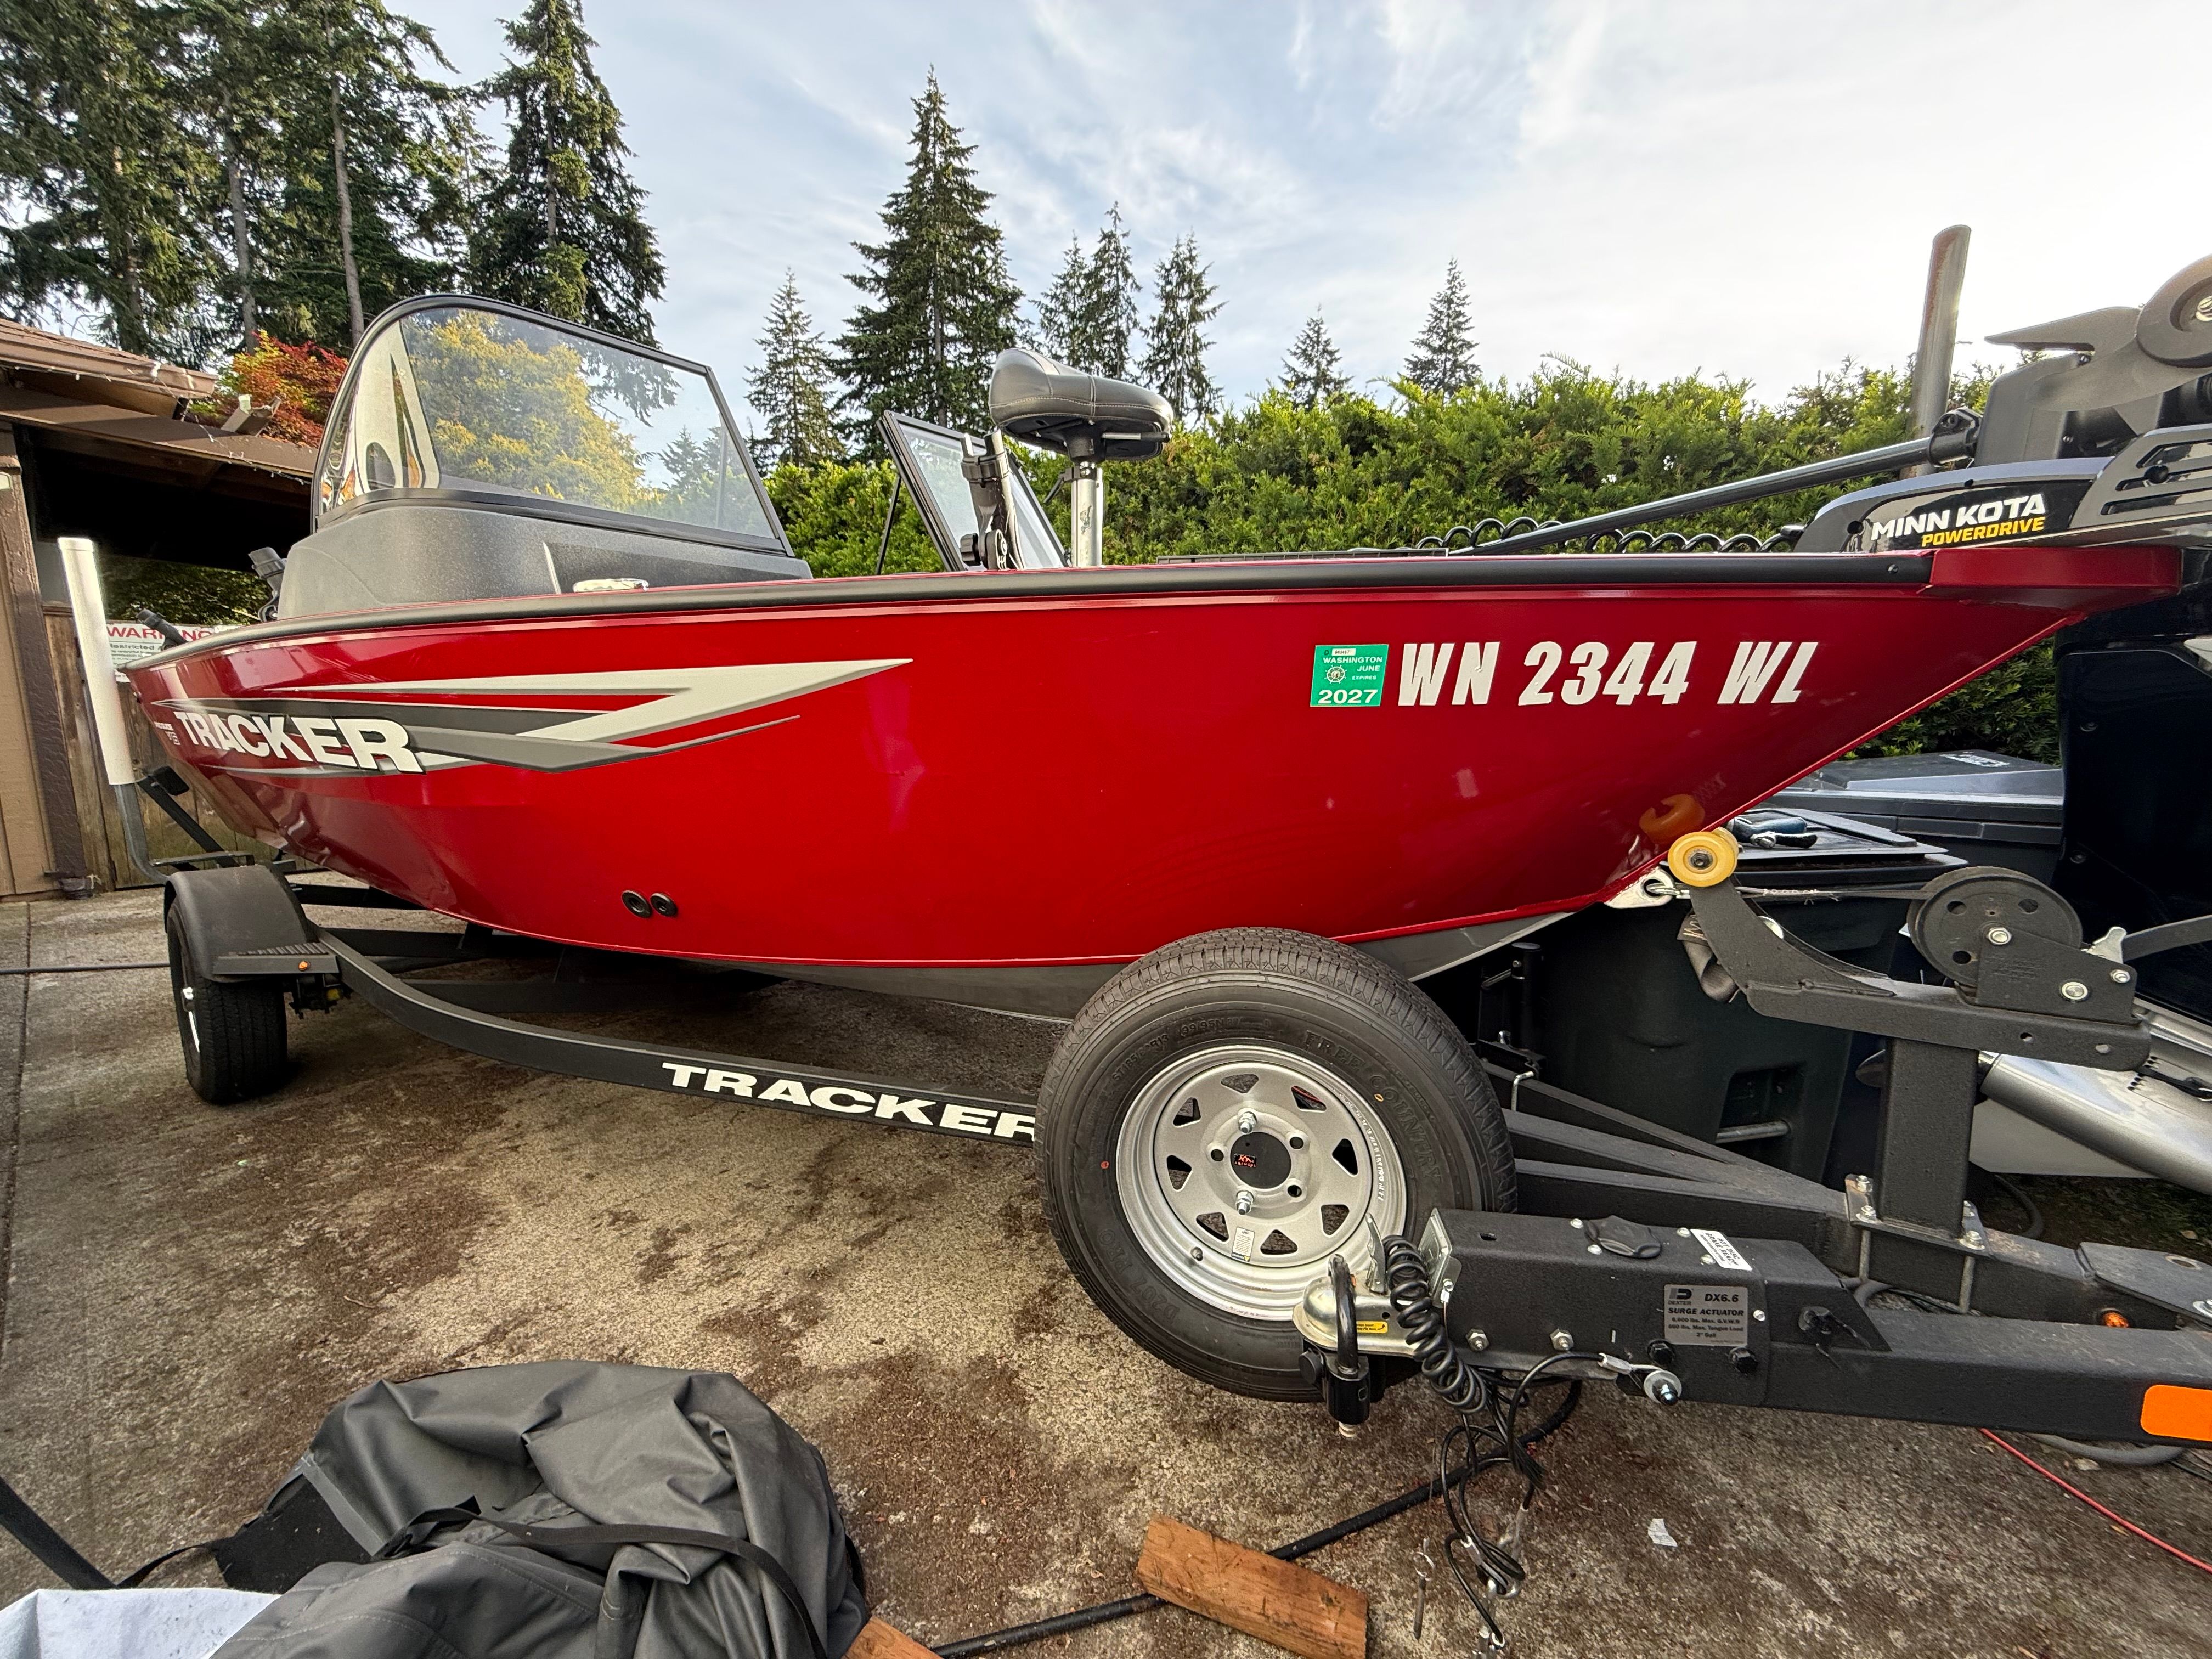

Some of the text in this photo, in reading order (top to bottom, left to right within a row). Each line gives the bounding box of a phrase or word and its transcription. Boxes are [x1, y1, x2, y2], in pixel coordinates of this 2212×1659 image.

[1871, 494, 2045, 540] MINN KOTA
[1922, 516, 2046, 547] POWERDRIVE
[107, 626, 213, 641] WARN
[1398, 641, 1818, 706] WN 2344 WL
[1318, 689, 1378, 704] 2027
[173, 711, 424, 772] TRACKER
[662, 1062, 1036, 1141] TRACKER
[1304, 1030, 1365, 1071] FREE
[1370, 1074, 1442, 1182] COUNTRY
[1705, 1233, 1723, 1248] BRAKE
[1720, 1249, 1739, 1265] READY
[1717, 1238, 1740, 1260] NOT DISC
[1705, 1294, 1739, 1302] DX6.6
